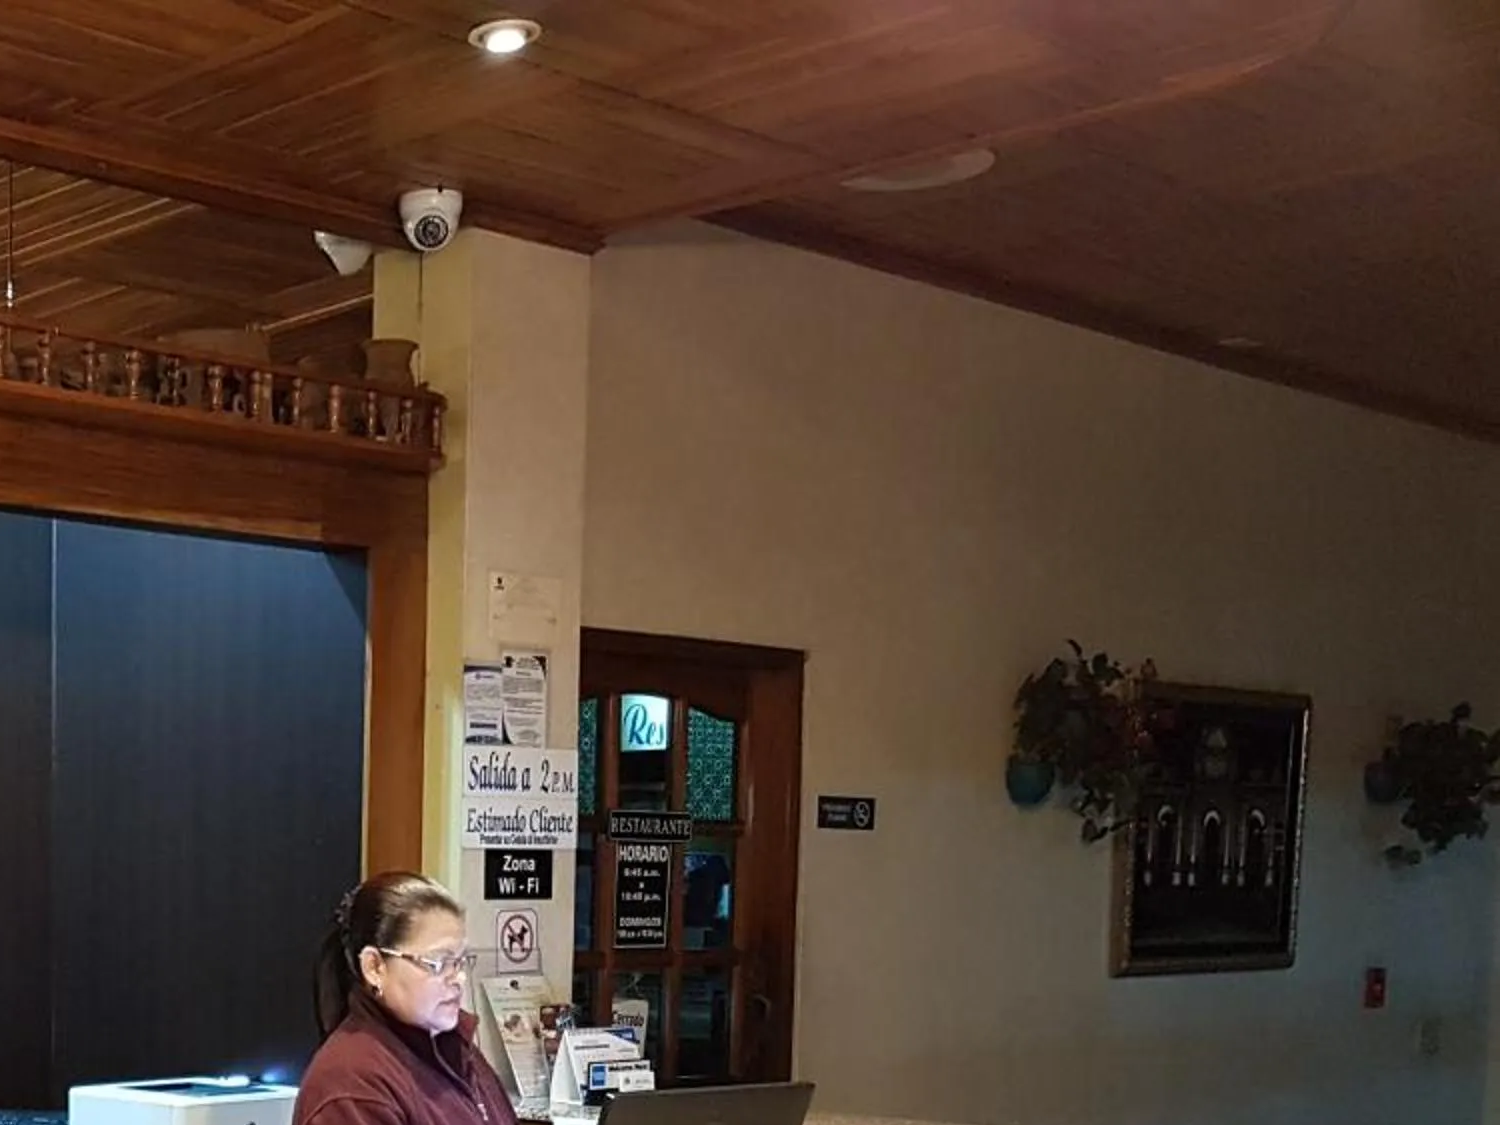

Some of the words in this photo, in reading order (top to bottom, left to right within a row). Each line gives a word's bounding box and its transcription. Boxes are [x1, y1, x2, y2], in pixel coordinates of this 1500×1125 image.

[467, 751, 517, 791] Salida
[521, 767, 531, 791] a
[540, 758, 550, 793] 2
[466, 804, 526, 833] Estimado
[529, 805, 573, 833] Cliente
[611, 817, 691, 836] RESTAURANTE
[619, 845, 668, 862] HORARIO
[503, 855, 536, 872] Zona
